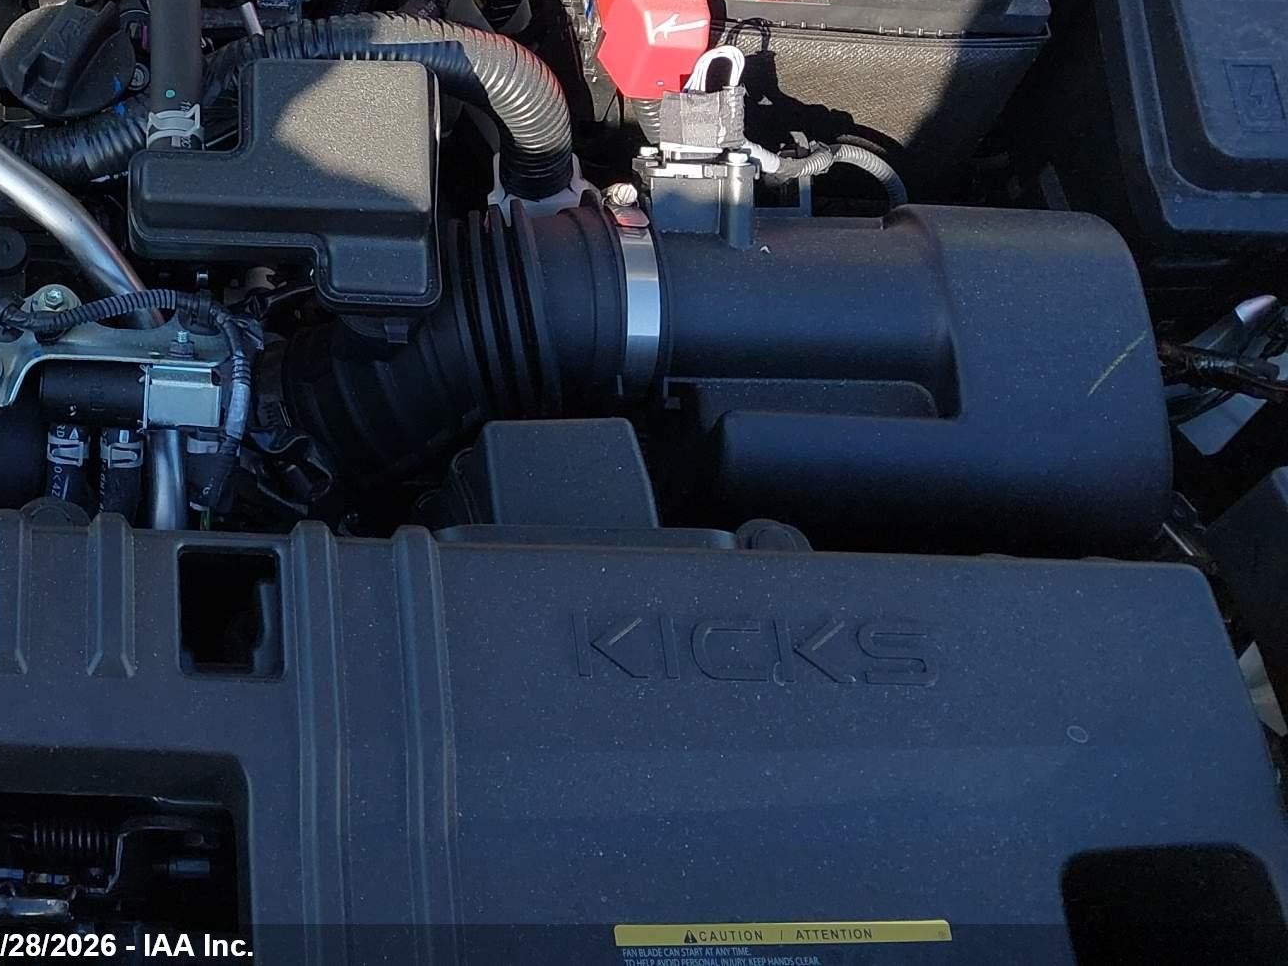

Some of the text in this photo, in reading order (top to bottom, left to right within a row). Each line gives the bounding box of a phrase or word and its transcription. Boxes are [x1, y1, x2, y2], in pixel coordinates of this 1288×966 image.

[572, 614, 940, 687] KICKS
[698, 930, 763, 942] CAUTION
[796, 929, 873, 941] ATTENTION
[623, 949, 638, 957] FAN
[639, 949, 662, 957] BLADE
[663, 948, 680, 956] CAN
[682, 948, 703, 956] START
[680, 958, 718, 966] PERSONAL
[749, 958, 766, 966] KEEP
[767, 957, 794, 966] HANDS
